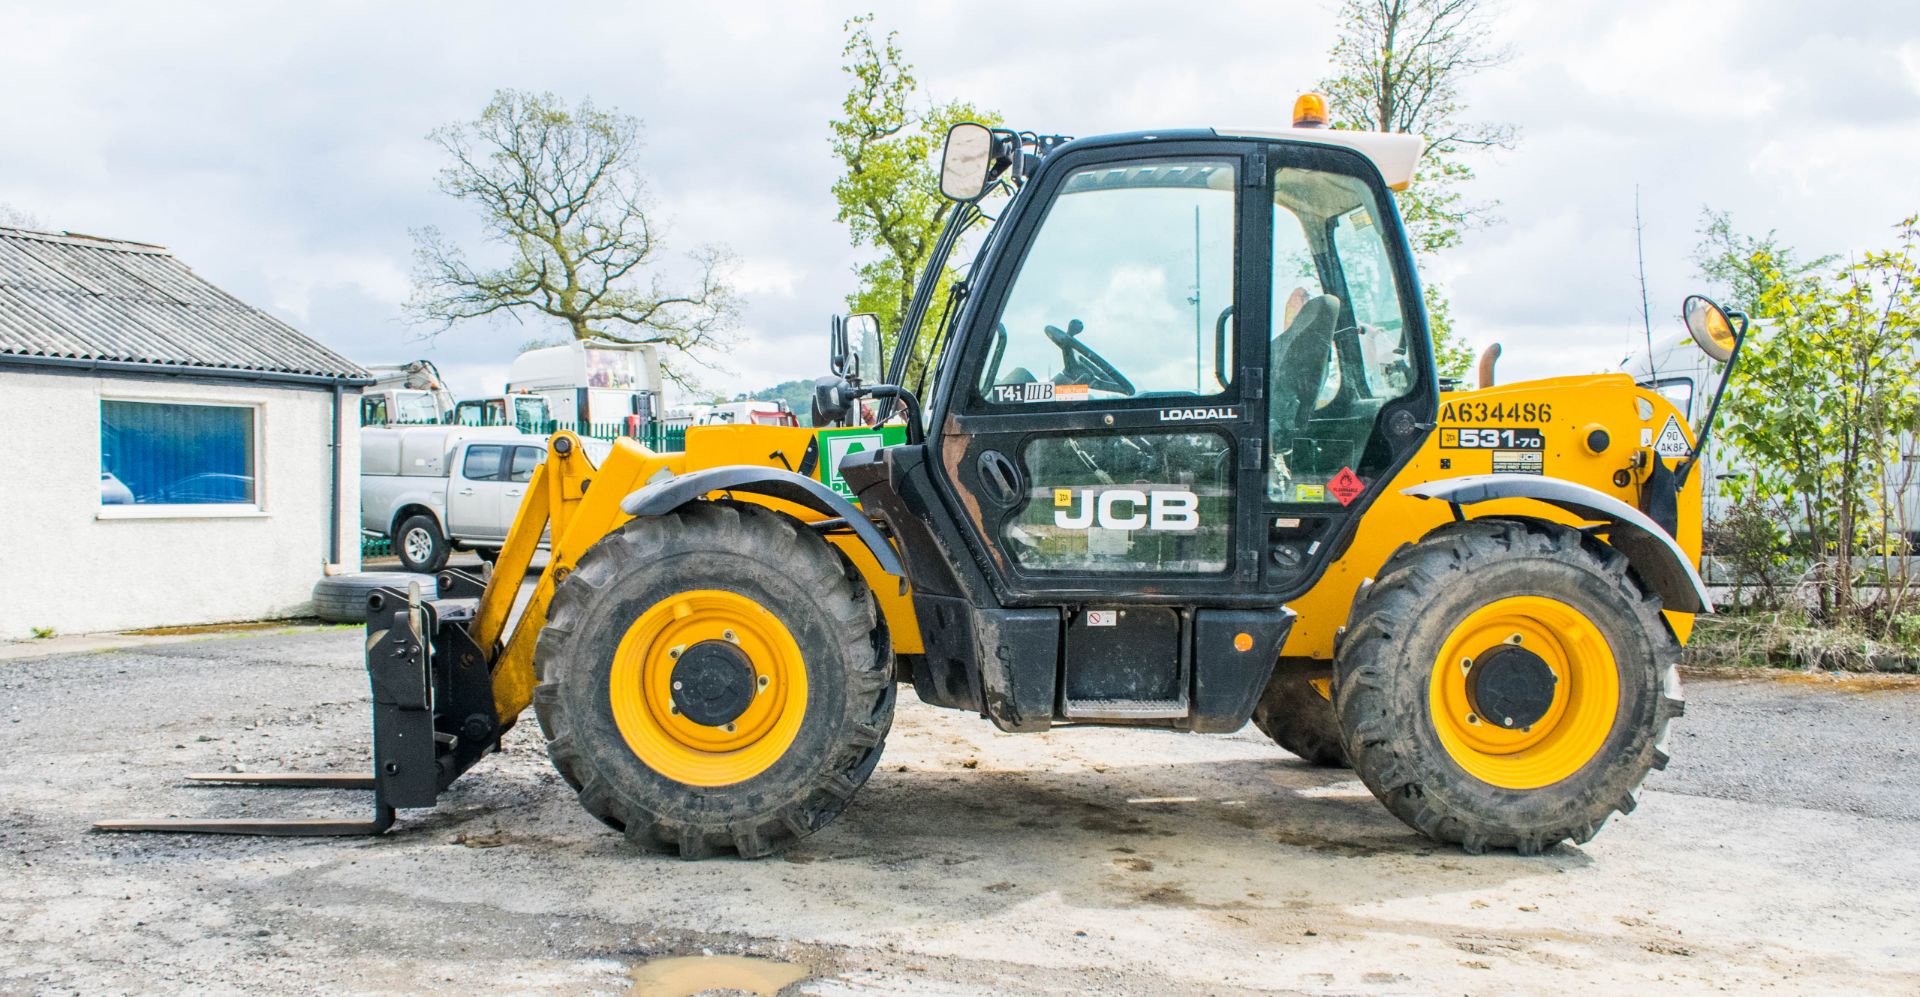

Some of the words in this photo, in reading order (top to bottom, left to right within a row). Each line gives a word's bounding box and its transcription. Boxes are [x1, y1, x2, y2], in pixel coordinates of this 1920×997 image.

[1160, 407, 1238, 421] LOADALL
[1459, 429, 1541, 448] 531-70
[1054, 489, 1200, 530] JCB
